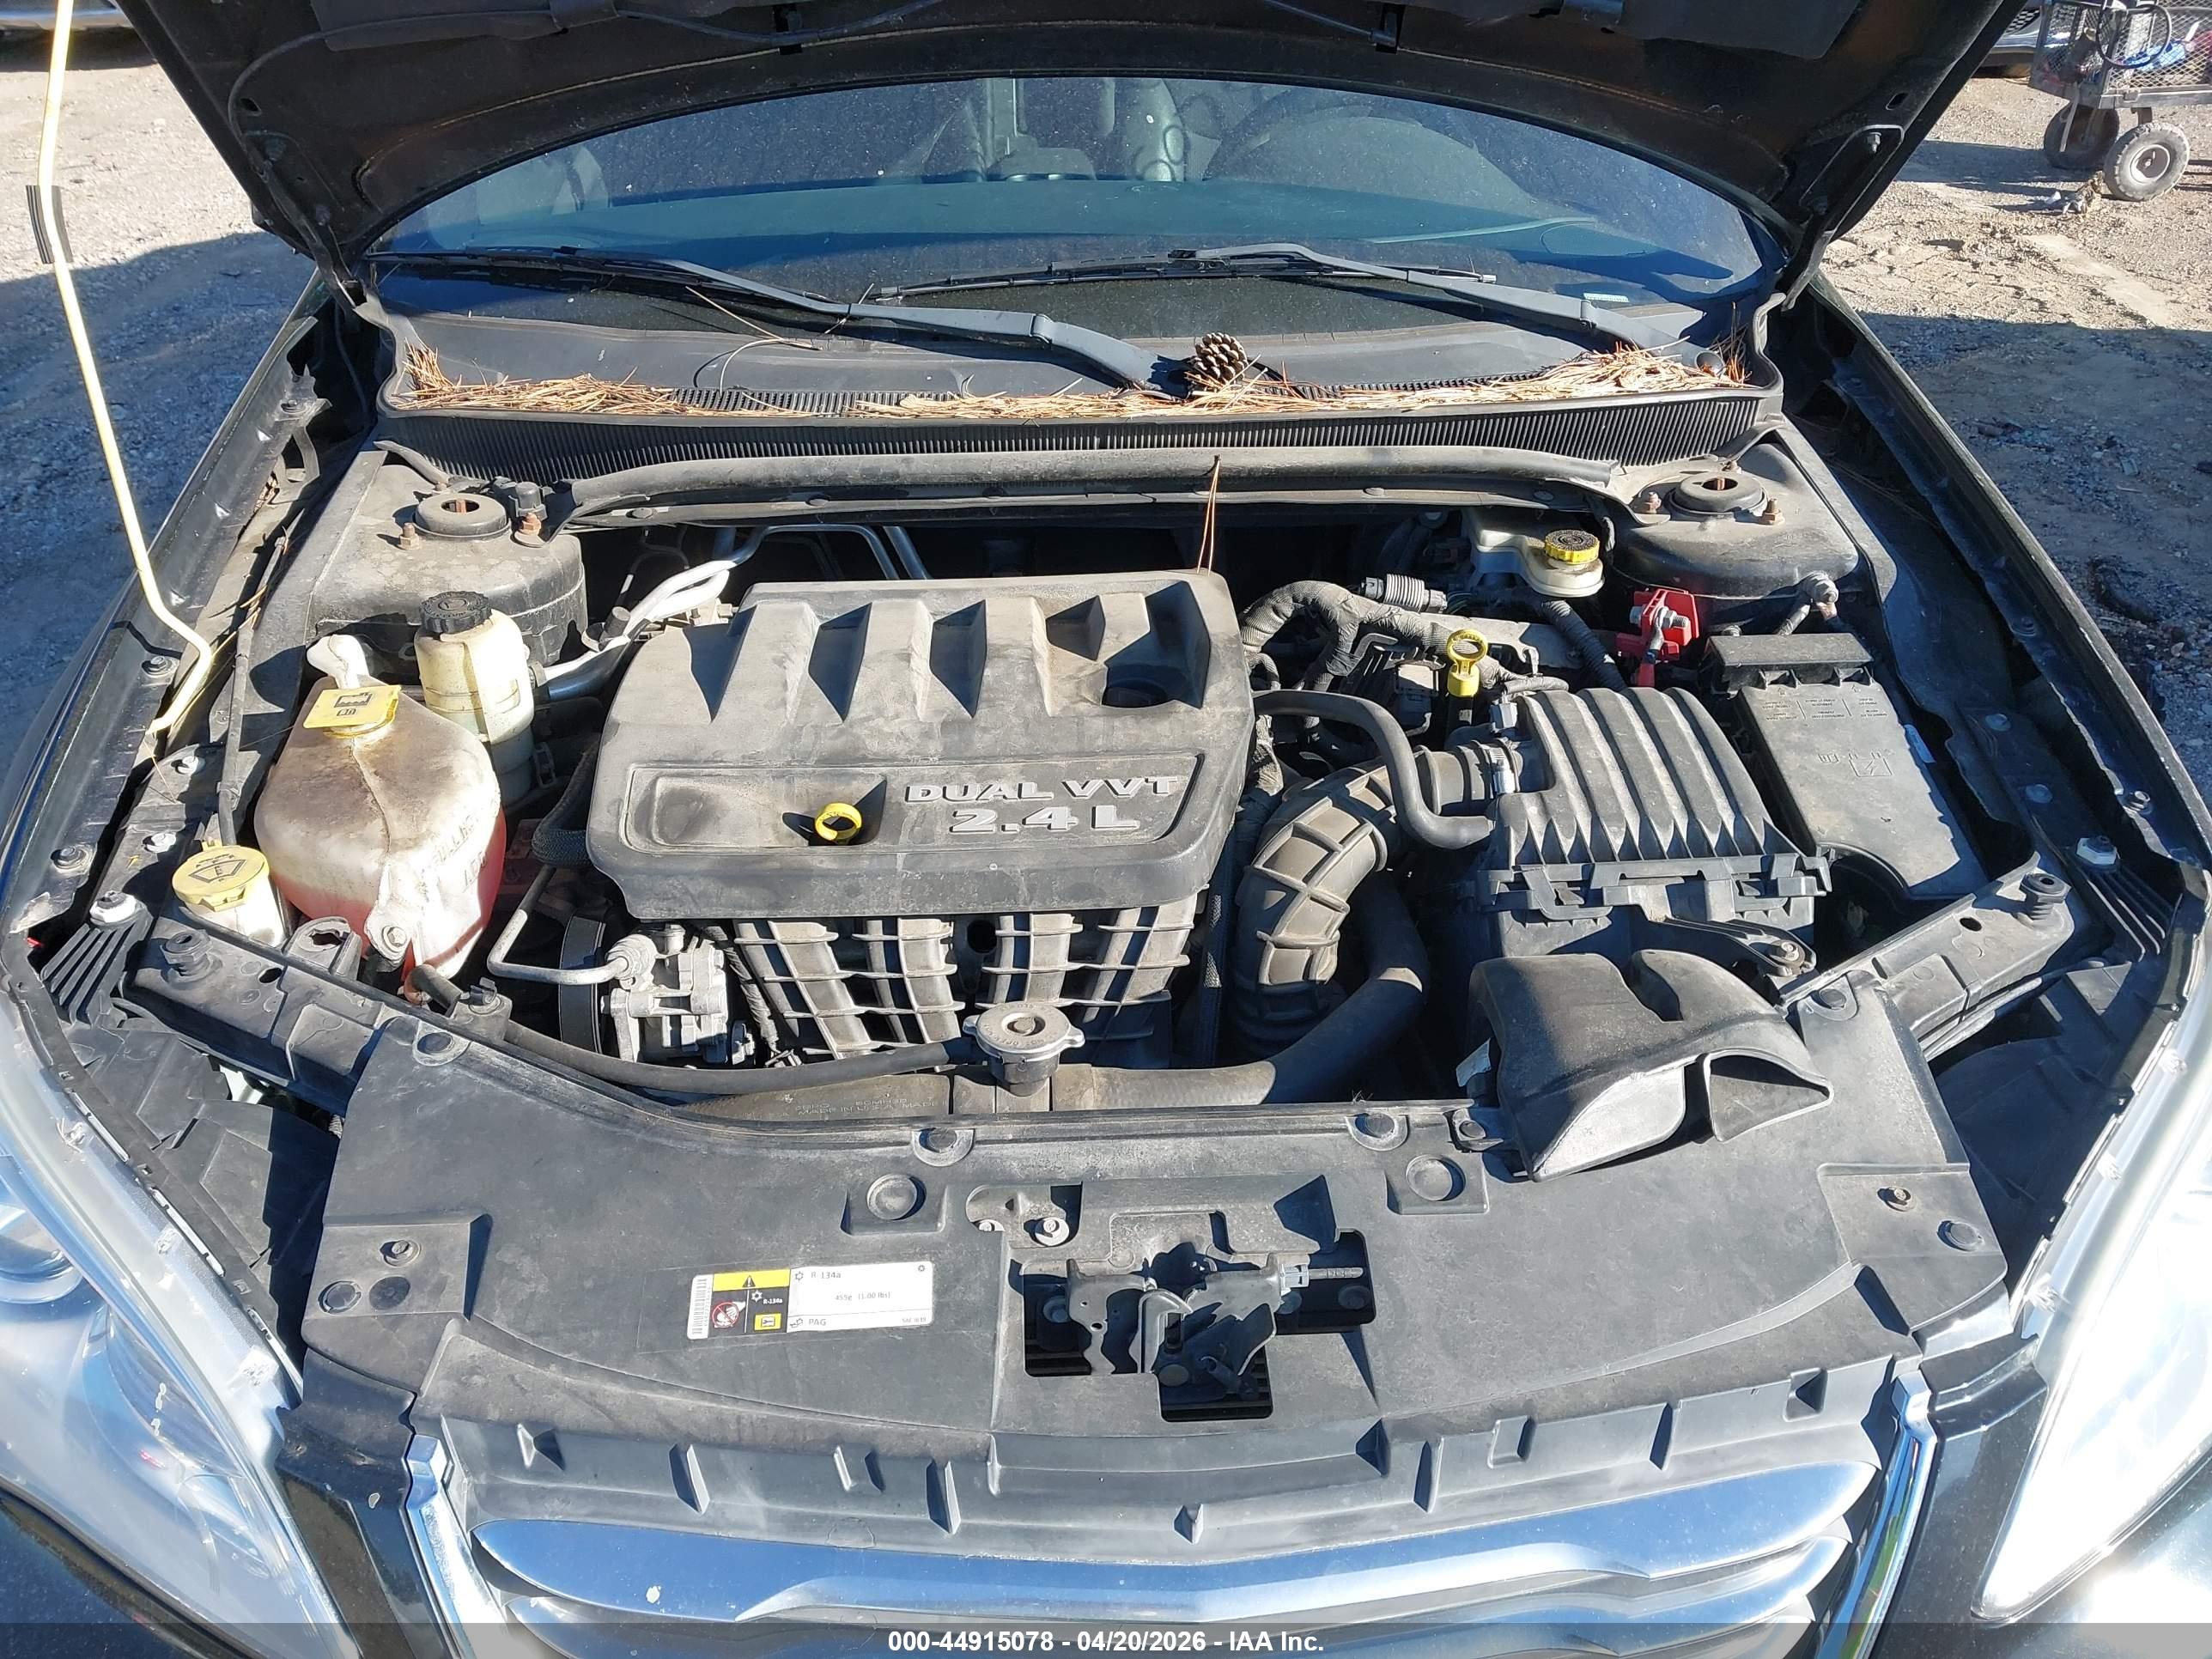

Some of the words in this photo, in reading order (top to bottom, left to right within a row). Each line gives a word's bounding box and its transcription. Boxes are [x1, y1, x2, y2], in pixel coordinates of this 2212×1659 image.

[904, 781, 1054, 804] DUAL
[1060, 775, 1178, 799] VVT
[808, 1317, 827, 1328] PAG
